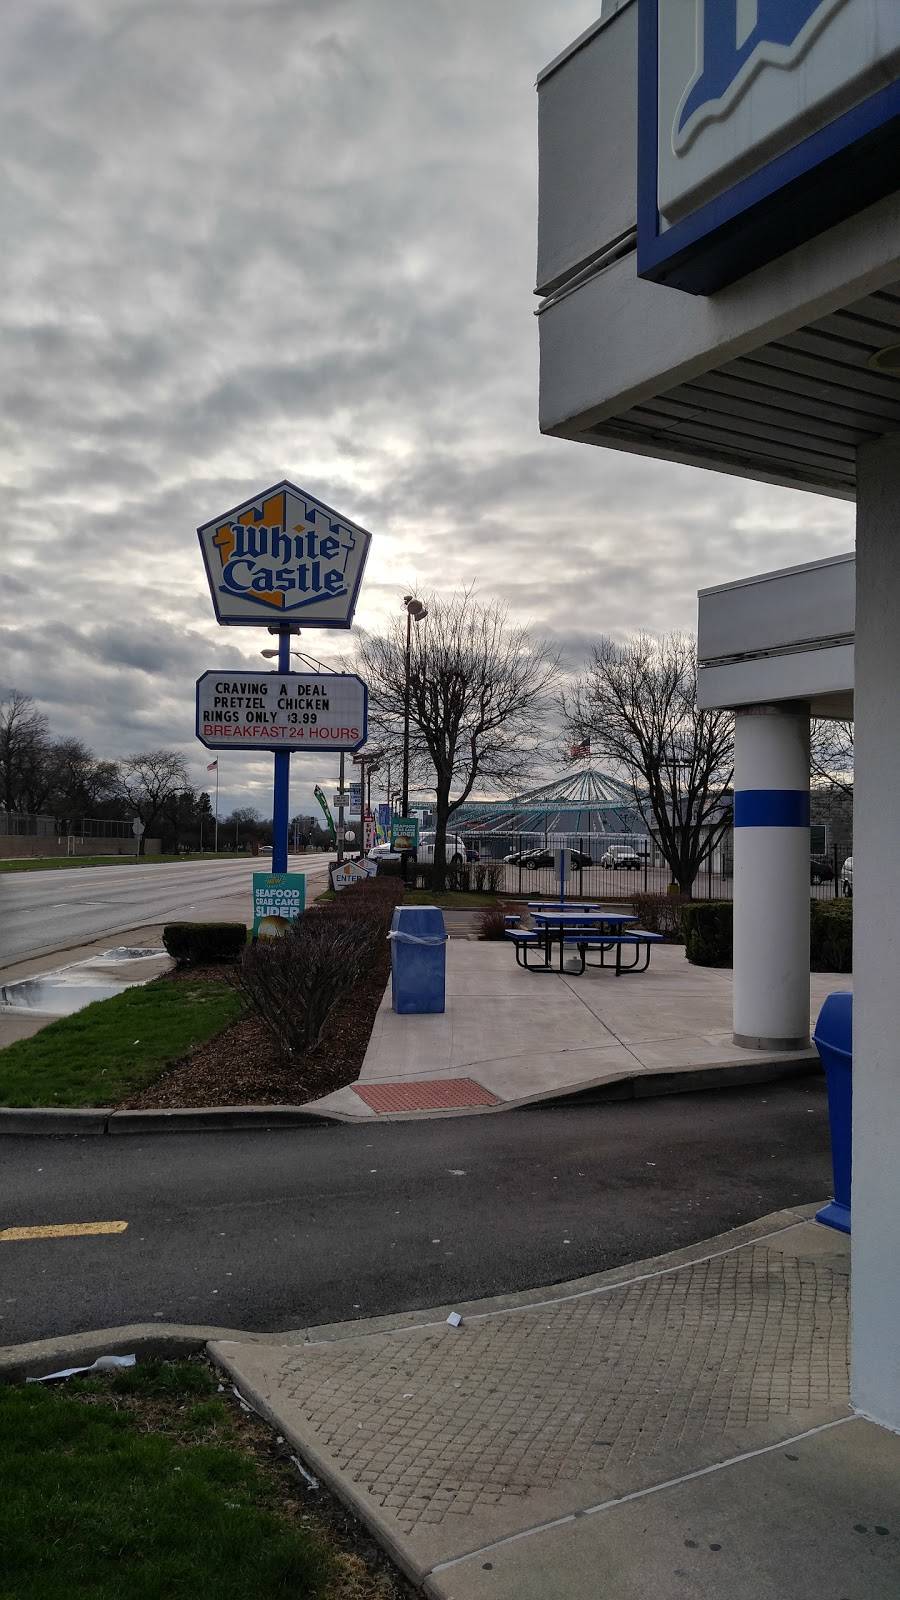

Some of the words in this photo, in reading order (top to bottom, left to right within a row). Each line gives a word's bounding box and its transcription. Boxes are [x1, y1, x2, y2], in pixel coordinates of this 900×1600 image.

[230, 524, 341, 564] White
[222, 559, 346, 593] Castle
[215, 682, 268, 695] CRAVING
[279, 683, 288, 695] A
[297, 684, 328, 696] DEAL
[214, 696, 266, 709] PRETZEL
[277, 697, 330, 711] CHICKEN
[203, 710, 240, 723] RINGS
[246, 711, 278, 724] ONLY
[203, 725, 288, 738] BREAKFAST
[288, 726, 305, 738] 24
[308, 727, 359, 740] HOURS
[255, 888, 300, 898] SEAFOOD
[255, 898, 273, 906] CRAB
[275, 898, 301, 906] CAKE
[255, 905, 300, 918] SLIDER
